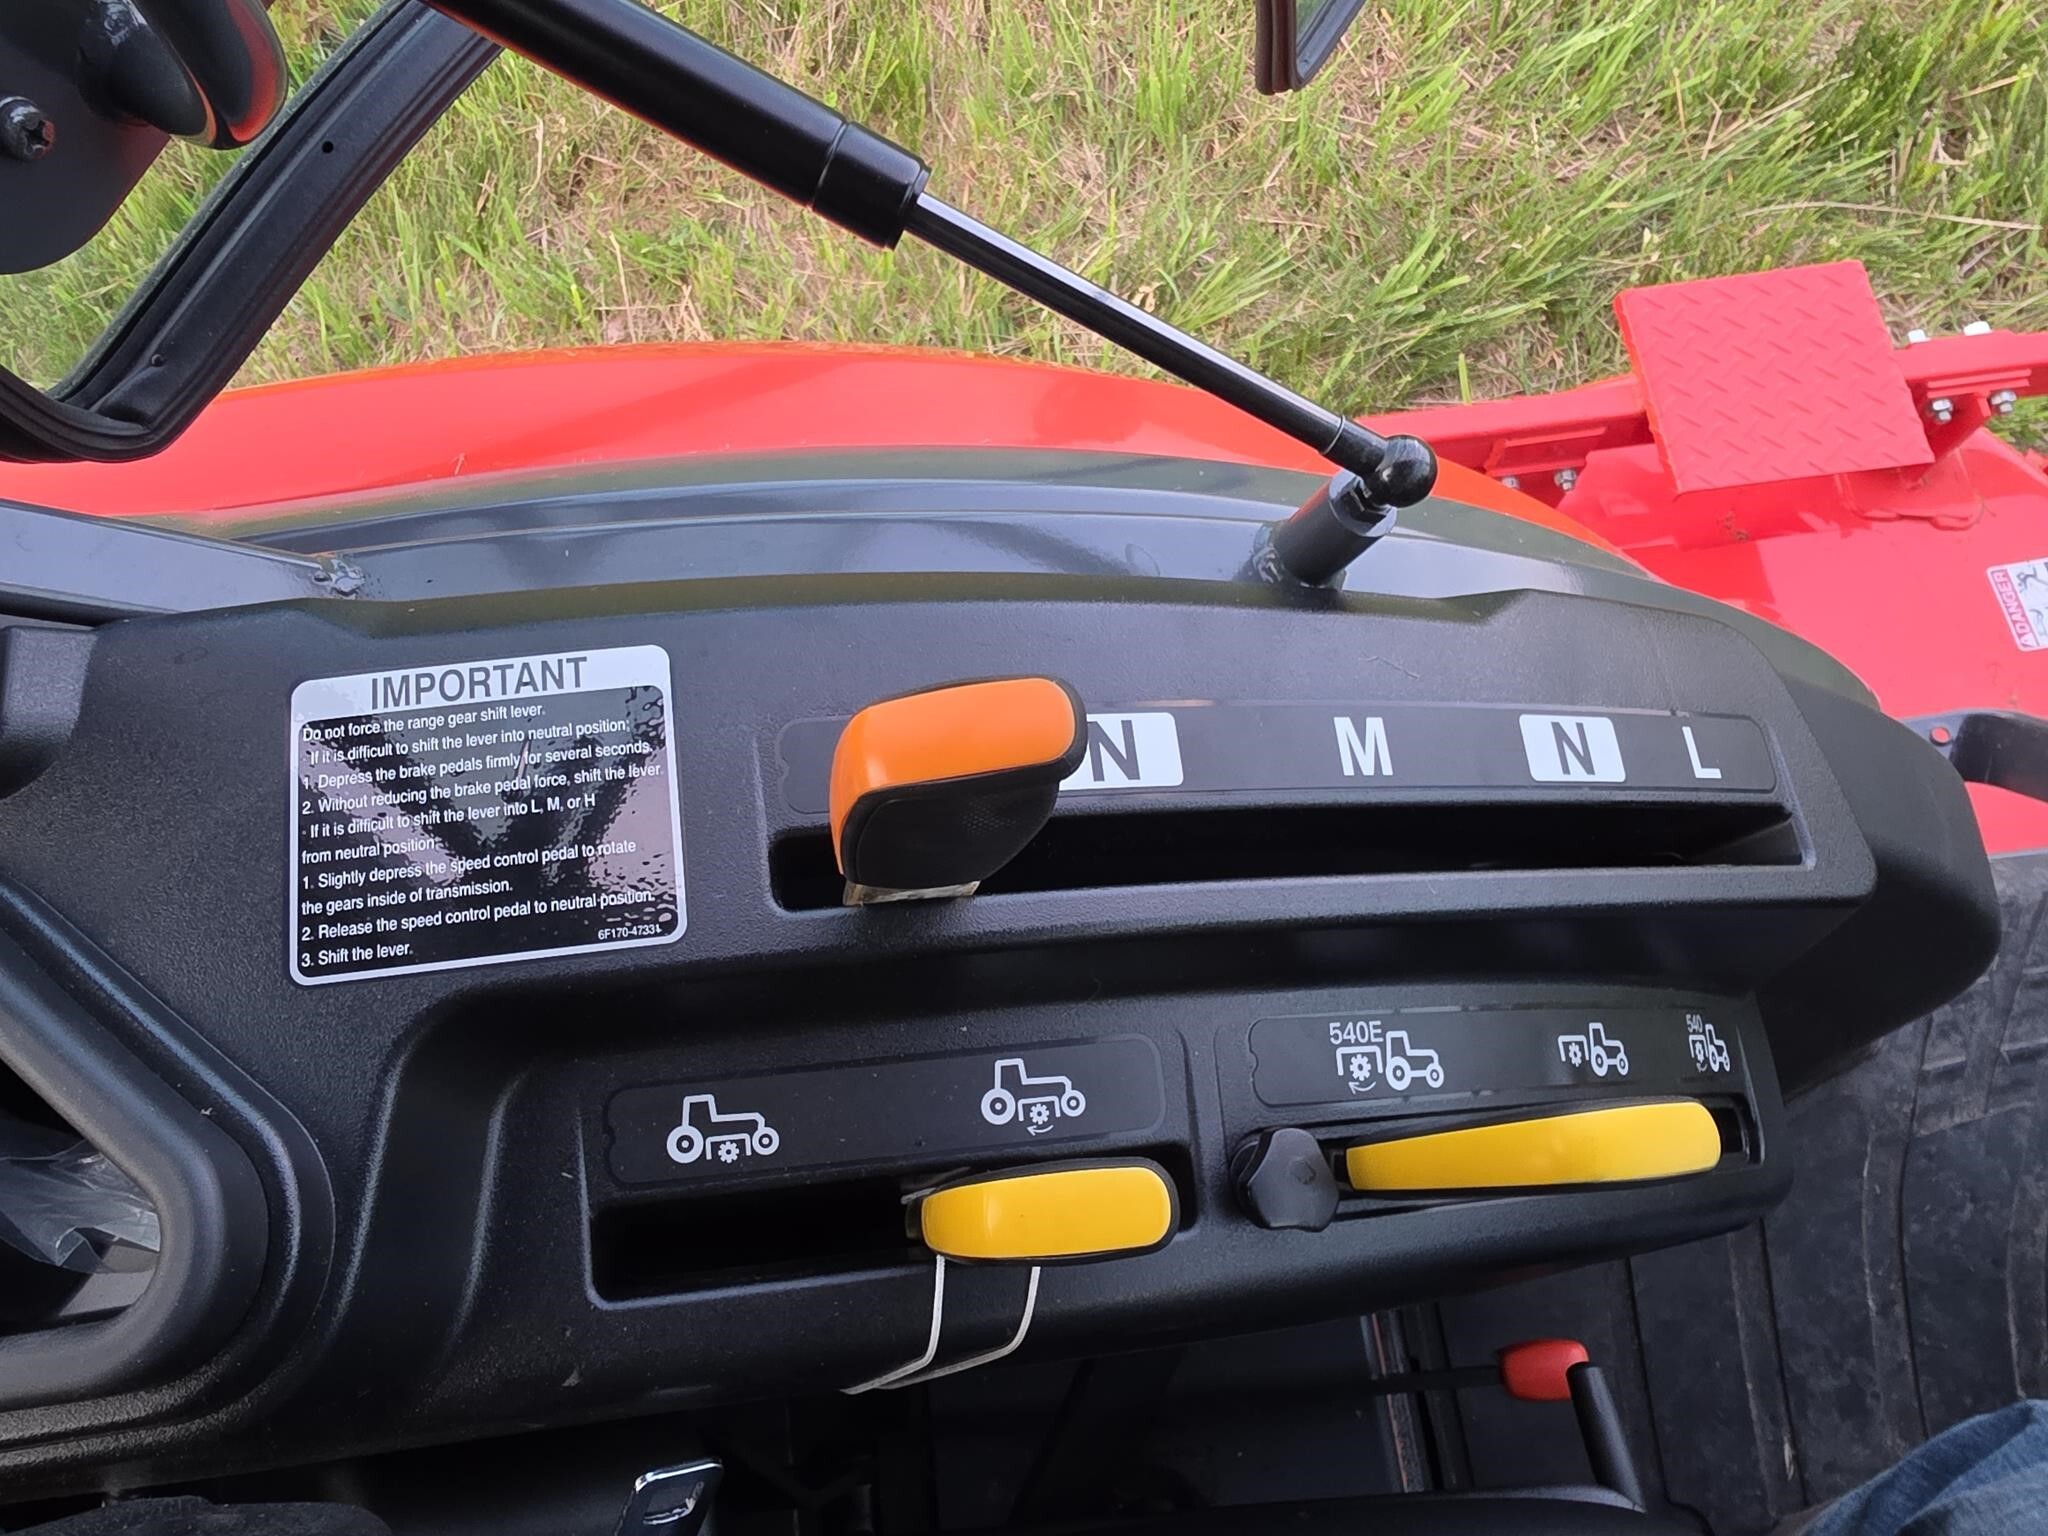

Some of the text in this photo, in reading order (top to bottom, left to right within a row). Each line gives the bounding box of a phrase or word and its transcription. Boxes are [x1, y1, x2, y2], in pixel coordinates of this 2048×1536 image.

[1992, 570, 2031, 634] DANGER
[371, 655, 588, 710] IMPORTANT
[302, 702, 545, 741] Do not force the range gear shift lever.
[310, 750, 318, 765] If
[322, 749, 329, 763] it
[333, 747, 344, 762] is
[346, 742, 393, 760] difficult
[395, 741, 409, 755] to
[411, 737, 439, 753] shift
[441, 734, 463, 750] the
[465, 730, 498, 747] lever
[501, 728, 525, 743] into
[527, 722, 572, 740] neutral
[318, 769, 372, 791] Depress
[375, 766, 396, 782] the
[398, 761, 436, 779] brake
[439, 756, 483, 777] pedals
[485, 751, 521, 772] firmly
[524, 749, 542, 765] for
[544, 743, 592, 763] several
[594, 737, 653, 757] seconds.
[1086, 716, 1722, 783] N M N L
[301, 799, 314, 814] 2.
[317, 793, 368, 813] Without
[370, 787, 427, 809] reducing
[429, 784, 451, 800] the
[454, 779, 491, 797] brake
[494, 775, 531, 795] pedal
[533, 770, 570, 789] force,
[573, 767, 602, 784] shift
[604, 764, 626, 781] the
[309, 792, 596, 838] If it is difficult to shift the lever into L, M, or H
[301, 847, 331, 864] from
[334, 842, 380, 861] neutral
[302, 838, 637, 891] 1. Slightly depress the speed control pedal to rotate
[301, 876, 513, 916] the gears inside of transmission.
[301, 885, 656, 941] 2. Release the speed control pedal to neutral position.
[301, 939, 414, 968] 3. Shift the lever.
[1328, 1020, 1384, 1045] 540E
[1685, 1013, 1704, 1033] 540
